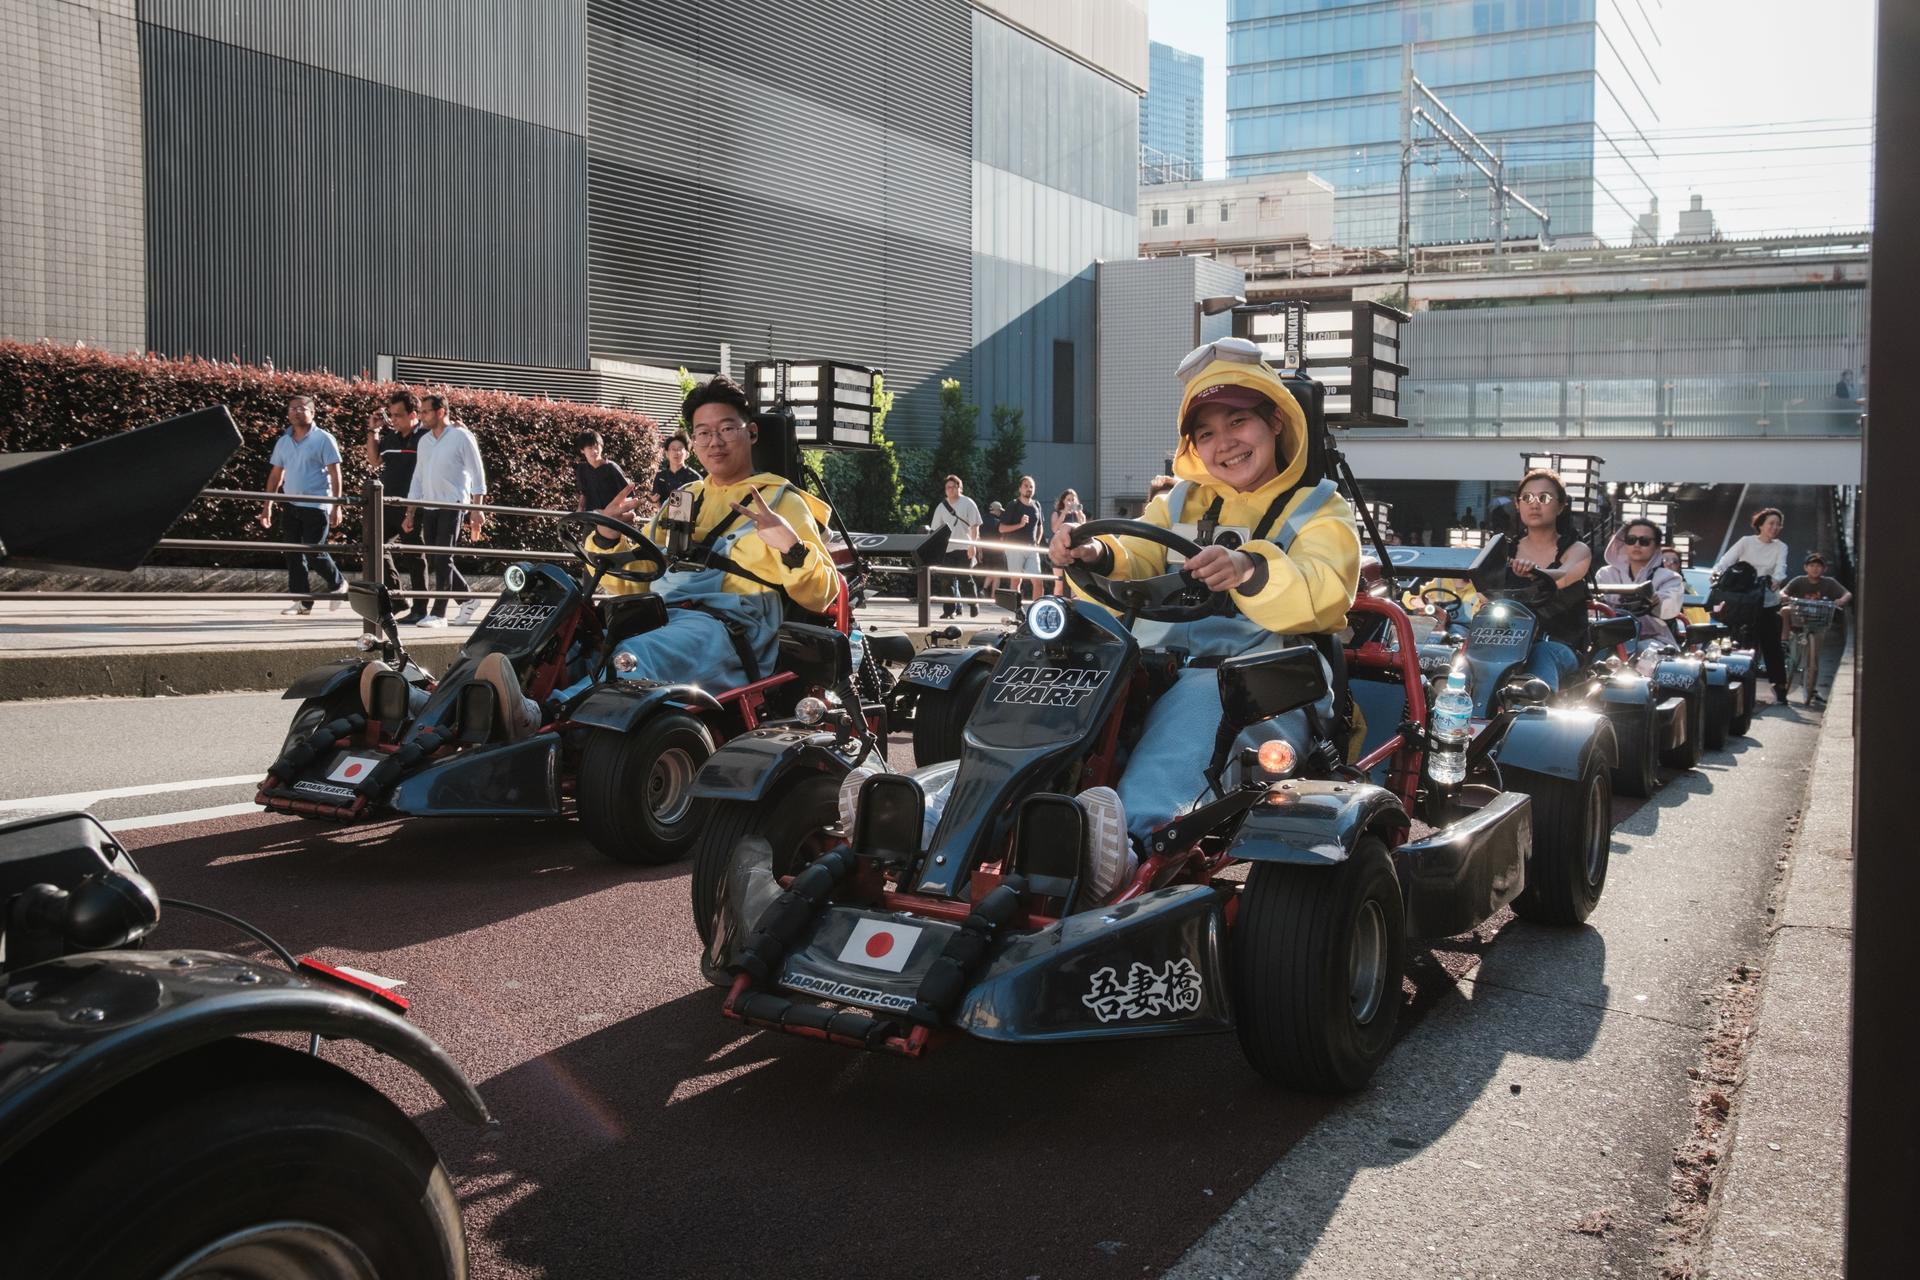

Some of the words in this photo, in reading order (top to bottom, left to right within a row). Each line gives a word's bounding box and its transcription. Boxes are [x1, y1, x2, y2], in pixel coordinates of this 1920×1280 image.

[489, 604, 557, 619] JAPAN
[486, 616, 543, 630] KART
[1471, 627, 1529, 639] JAPAN
[1475, 636, 1523, 645] KART
[993, 666, 1111, 688] JAPAN
[993, 684, 1093, 706] KART
[783, 972, 837, 994] JAPAN
[1082, 958, 1202, 1023] 吾妻橋
